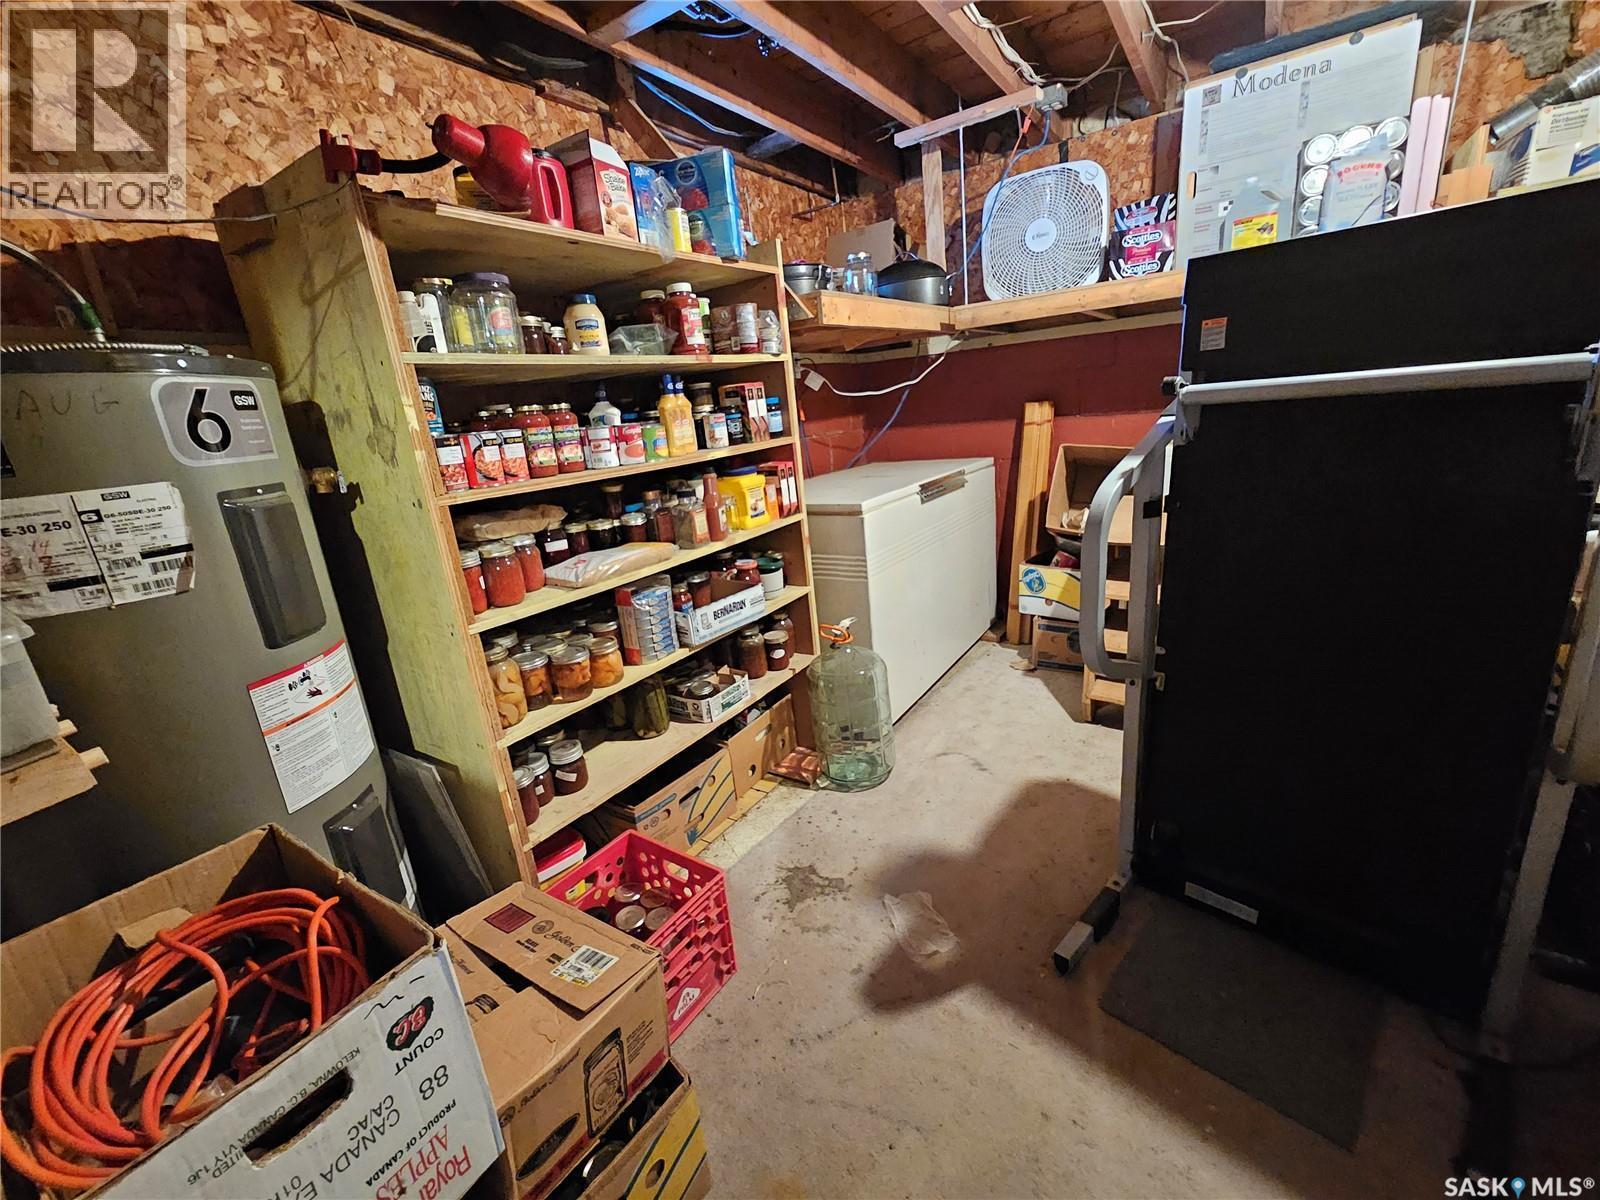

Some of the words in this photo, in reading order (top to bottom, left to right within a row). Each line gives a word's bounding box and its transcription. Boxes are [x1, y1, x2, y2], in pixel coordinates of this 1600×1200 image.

[1232, 59, 1332, 98] Modena
[1123, 231, 1161, 248] Scotties
[1122, 261, 1159, 276] Scotties
[234, 395, 255, 406] GSW
[187, 387, 232, 454] 6
[103, 491, 128, 500] GSW
[41, 519, 72, 533] 250
[713, 599, 747, 620] BERNARDIN
[394, 1027, 444, 1076] COUNT
[418, 1064, 450, 1101] 88
[237, 1104, 287, 1144] CANADA
[347, 1094, 394, 1142] CA/AC
[417, 1098, 457, 1140] PRODUCT
[319, 1108, 401, 1184] CANADA
[375, 1124, 449, 1200] APPLES
[405, 1137, 418, 1151] OF
[365, 1149, 405, 1187] CANADA
